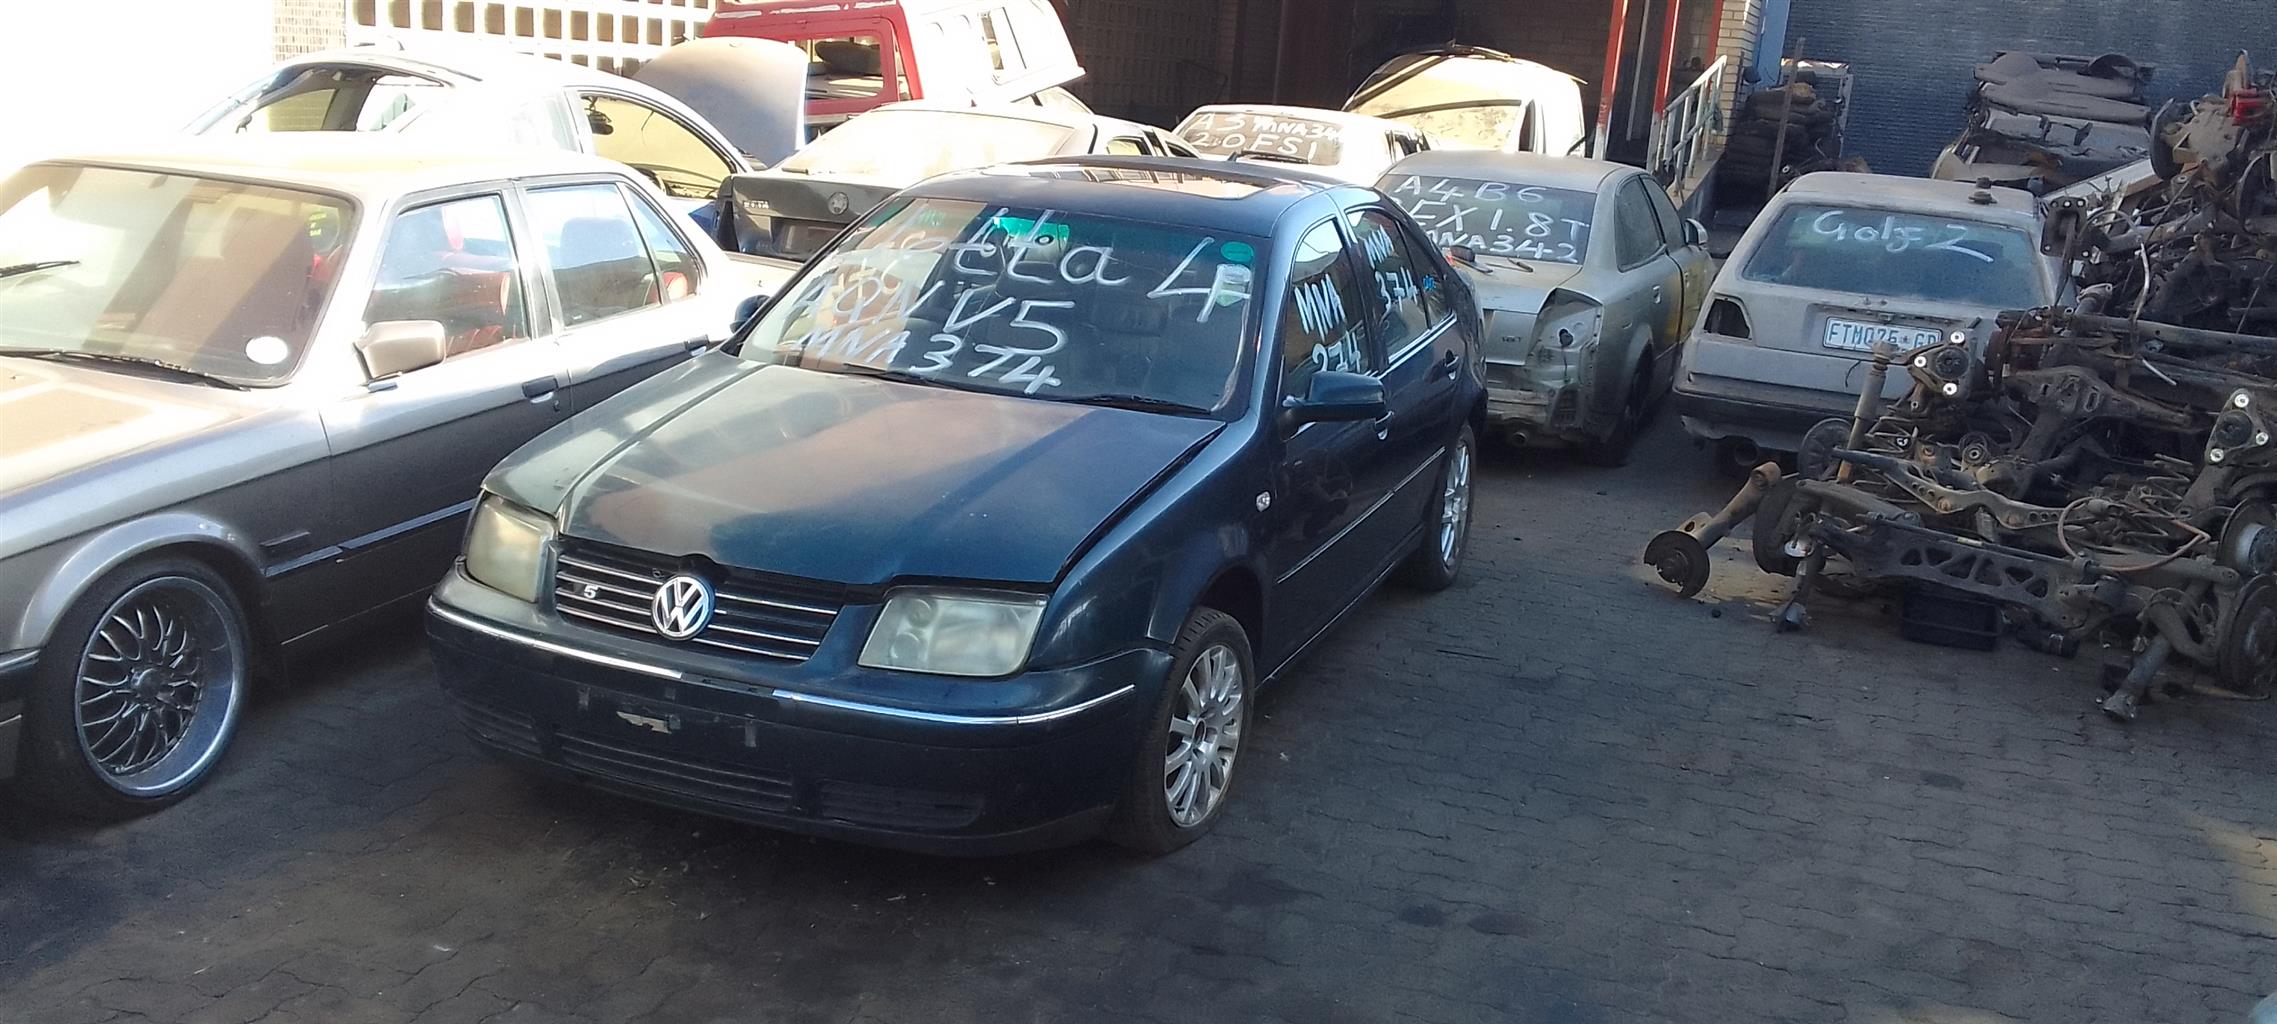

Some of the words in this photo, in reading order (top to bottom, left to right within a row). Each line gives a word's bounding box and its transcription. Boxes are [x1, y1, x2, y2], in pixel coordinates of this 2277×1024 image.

[1394, 175, 1464, 202] A4
[1474, 183, 1548, 203] B6
[1391, 197, 1478, 232] EX
[1926, 224, 1994, 263] 2
[1146, 236, 1251, 323] 4
[942, 296, 1076, 357] V5
[1294, 273, 1346, 341] MNA
[583, 584, 599, 599] 5
